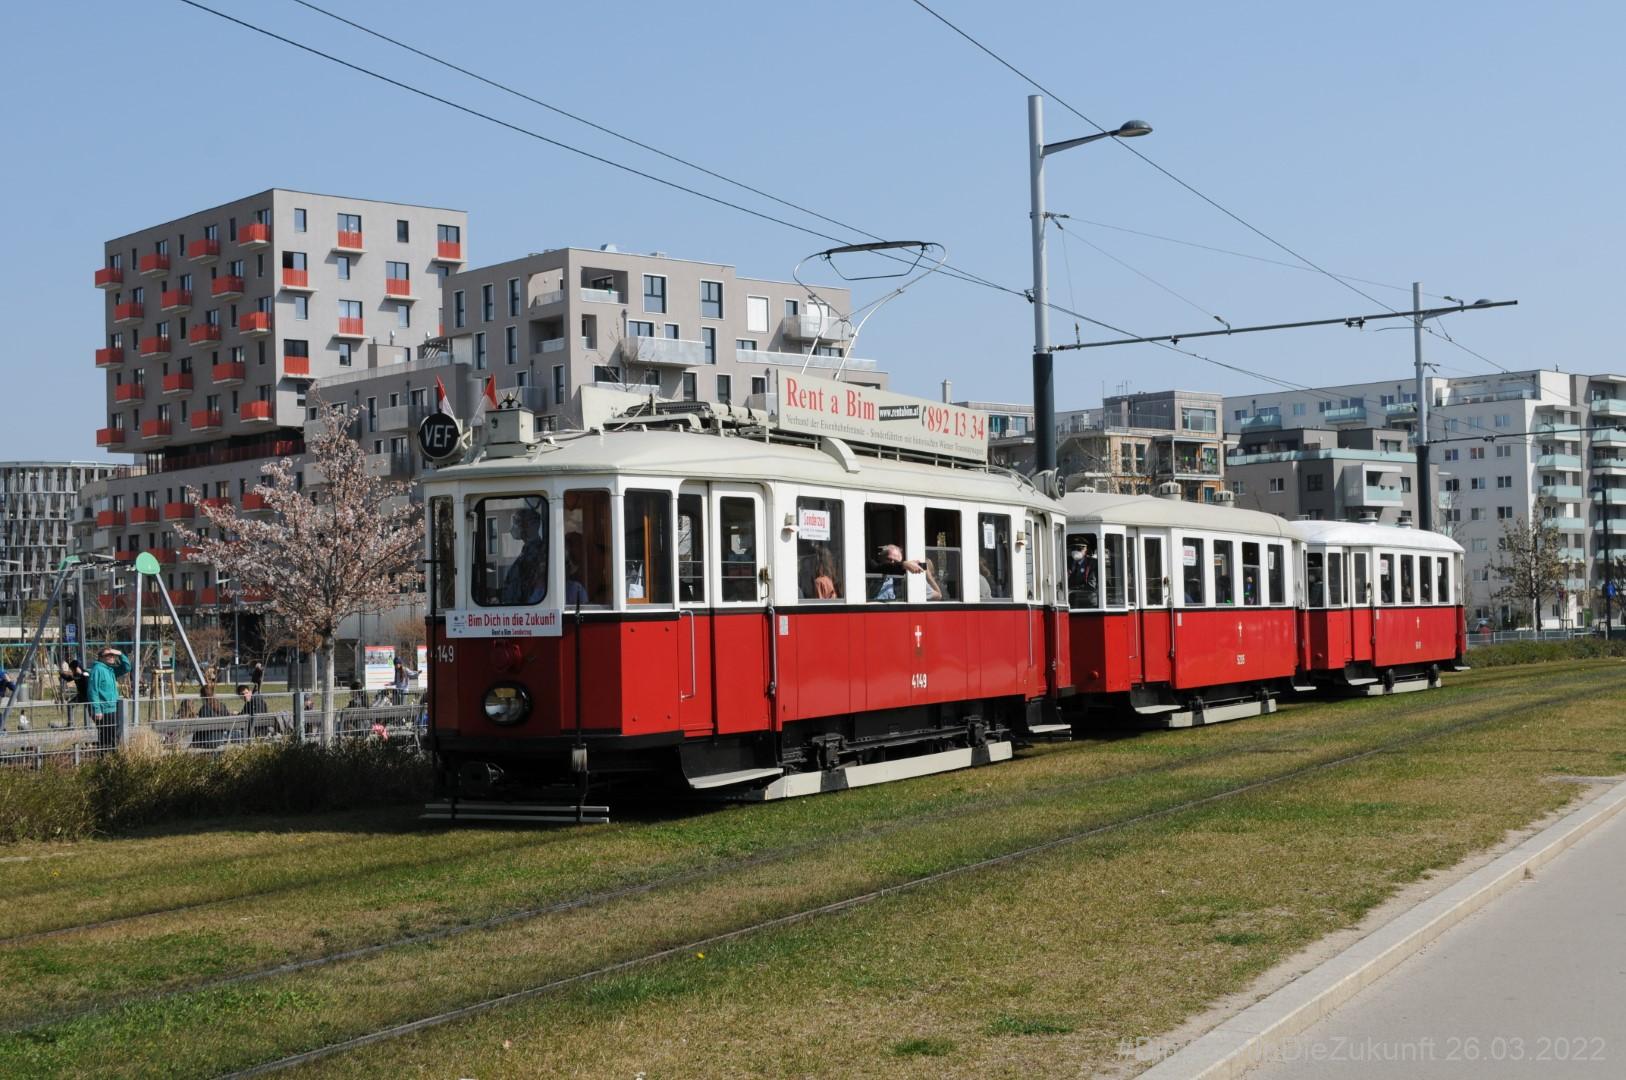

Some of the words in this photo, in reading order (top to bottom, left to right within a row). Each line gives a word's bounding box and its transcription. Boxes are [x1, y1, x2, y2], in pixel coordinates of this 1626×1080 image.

[786, 377, 824, 412] Rent
[831, 394, 839, 415] a
[846, 389, 875, 421] Bim
[928, 406, 949, 434] 892
[954, 412, 967, 437] 13
[970, 415, 985, 441] 34
[424, 424, 455, 448] VEF
[468, 613, 482, 627] Bim
[484, 613, 501, 626] Dich
[503, 613, 510, 626] in
[511, 612, 524, 626] die
[526, 612, 556, 626] Zukunft
[911, 673, 927, 689] 4149
